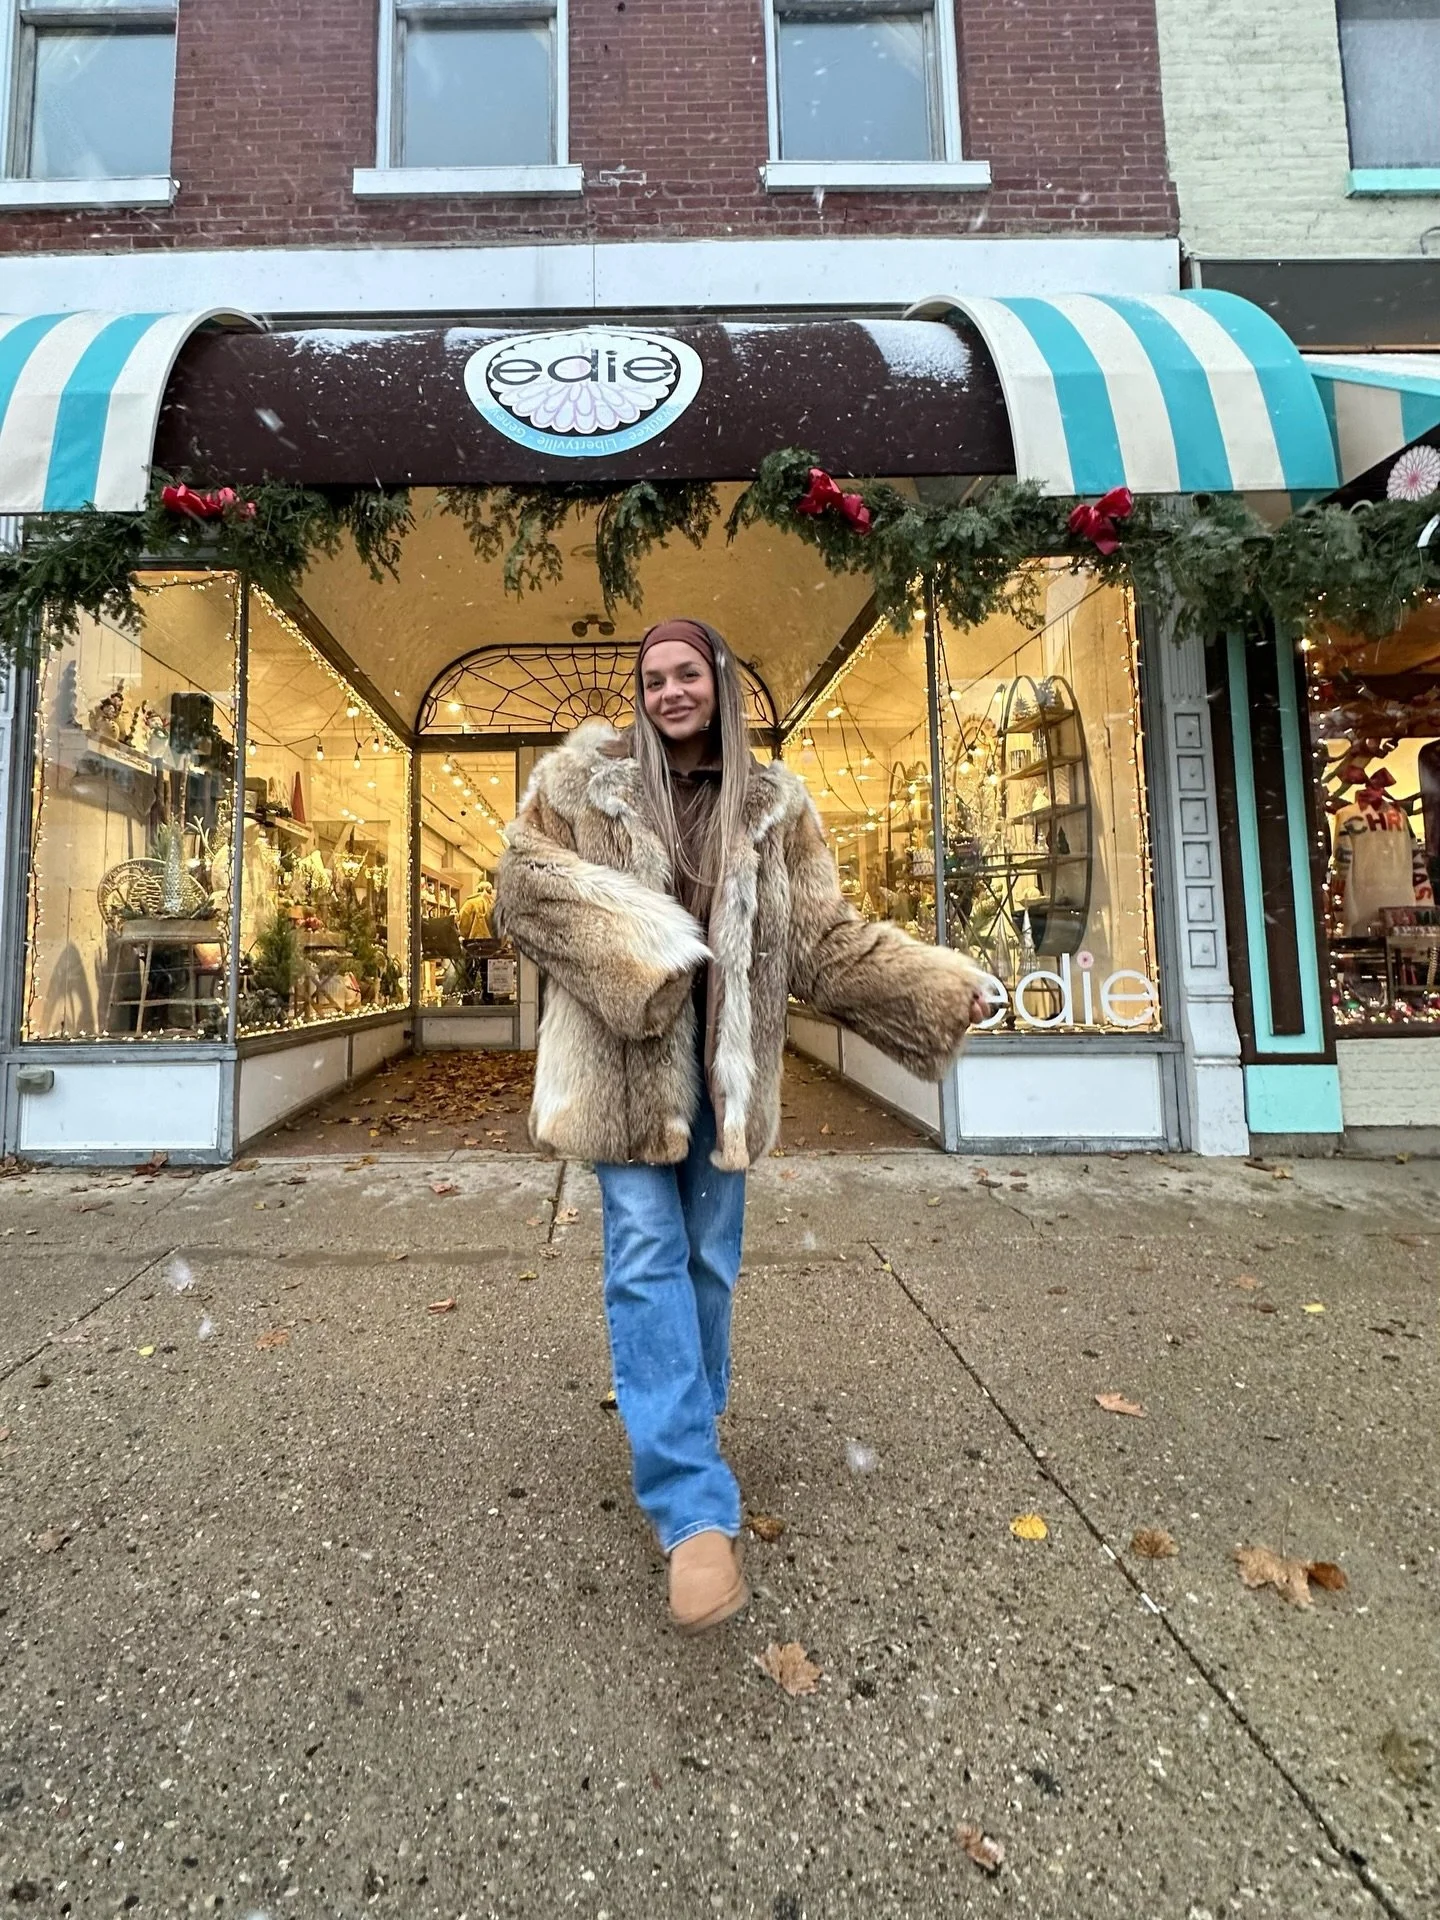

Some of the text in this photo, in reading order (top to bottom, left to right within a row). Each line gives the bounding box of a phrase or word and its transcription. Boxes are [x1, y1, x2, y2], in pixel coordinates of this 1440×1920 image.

[491, 348, 674, 386] edie
[488, 407, 527, 440] Genev
[536, 437, 618, 452] Libertyville
[970, 951, 1156, 1029] edie
